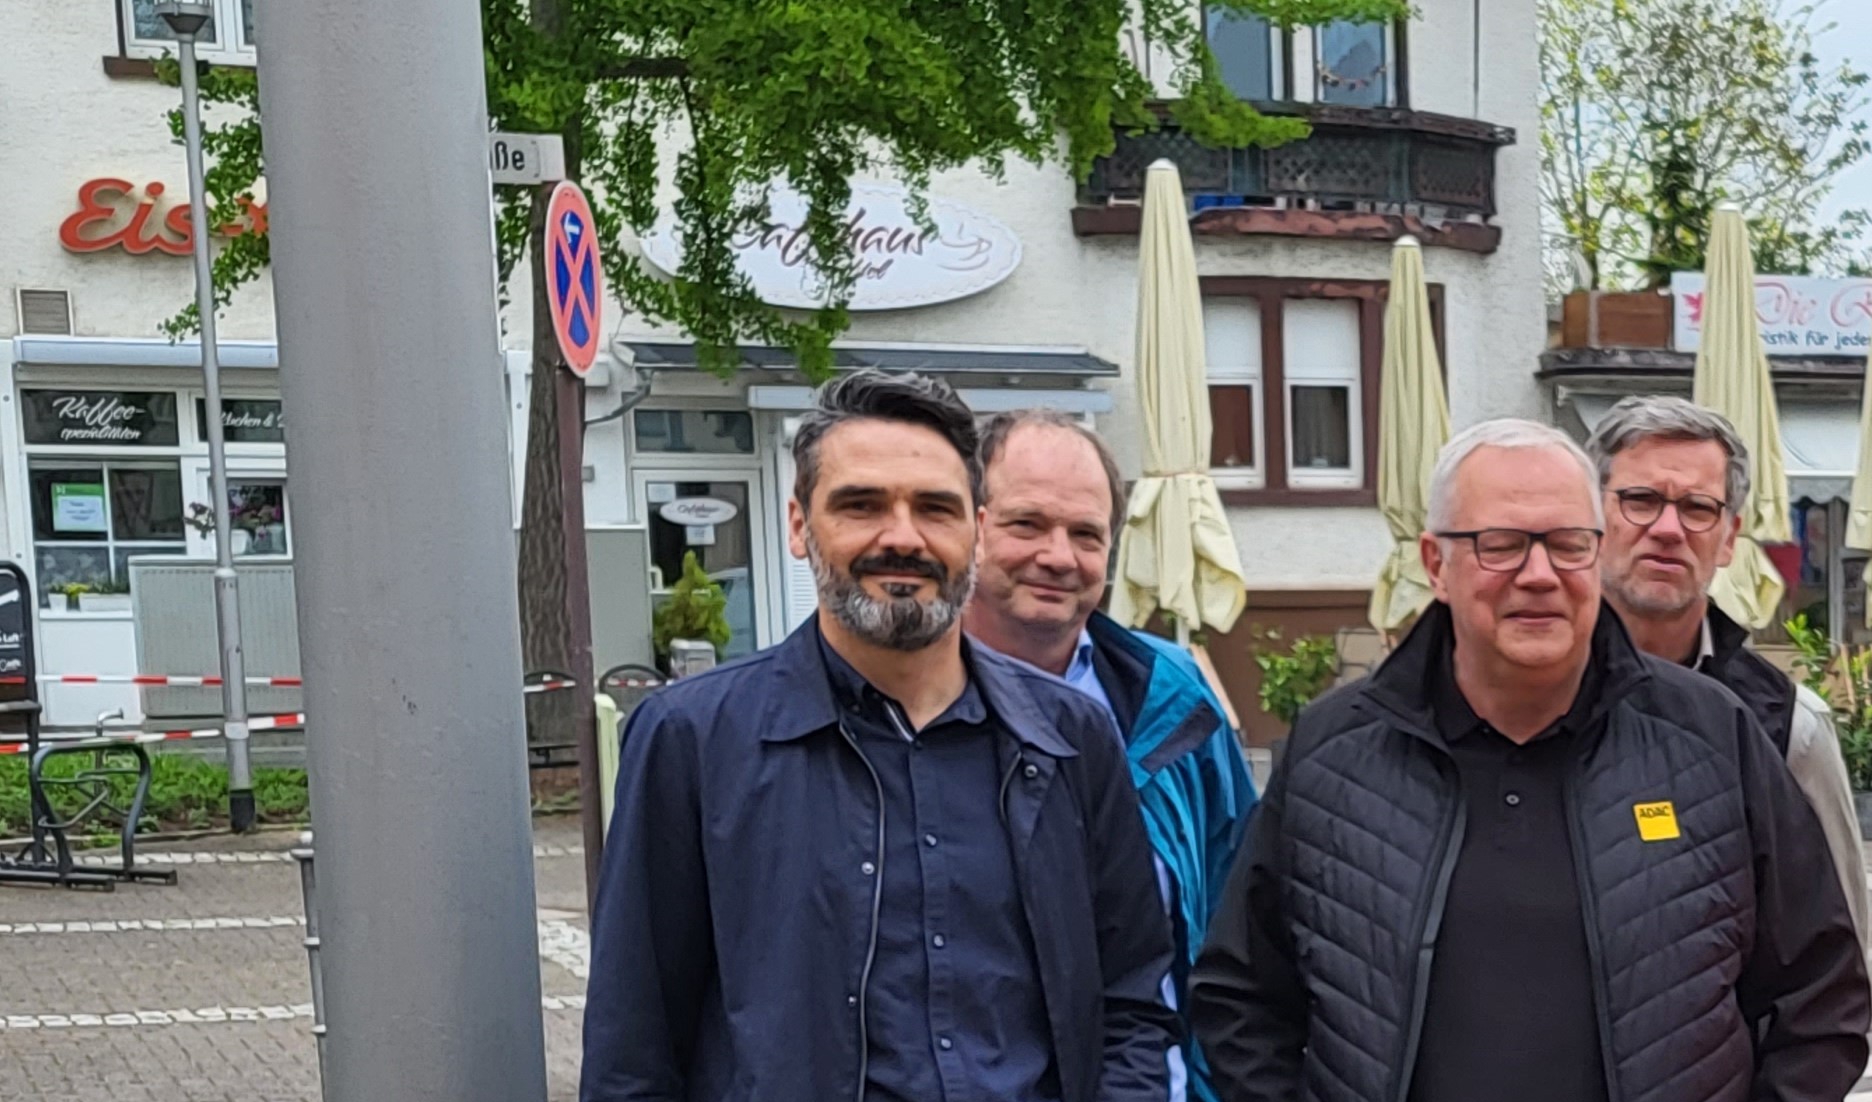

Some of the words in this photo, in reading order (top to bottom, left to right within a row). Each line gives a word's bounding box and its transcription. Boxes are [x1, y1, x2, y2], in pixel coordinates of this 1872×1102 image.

[490, 140, 525, 171] ße
[1805, 328, 1829, 346] für
[1834, 330, 1871, 350] jede
[52, 395, 147, 426] Kaffee-
